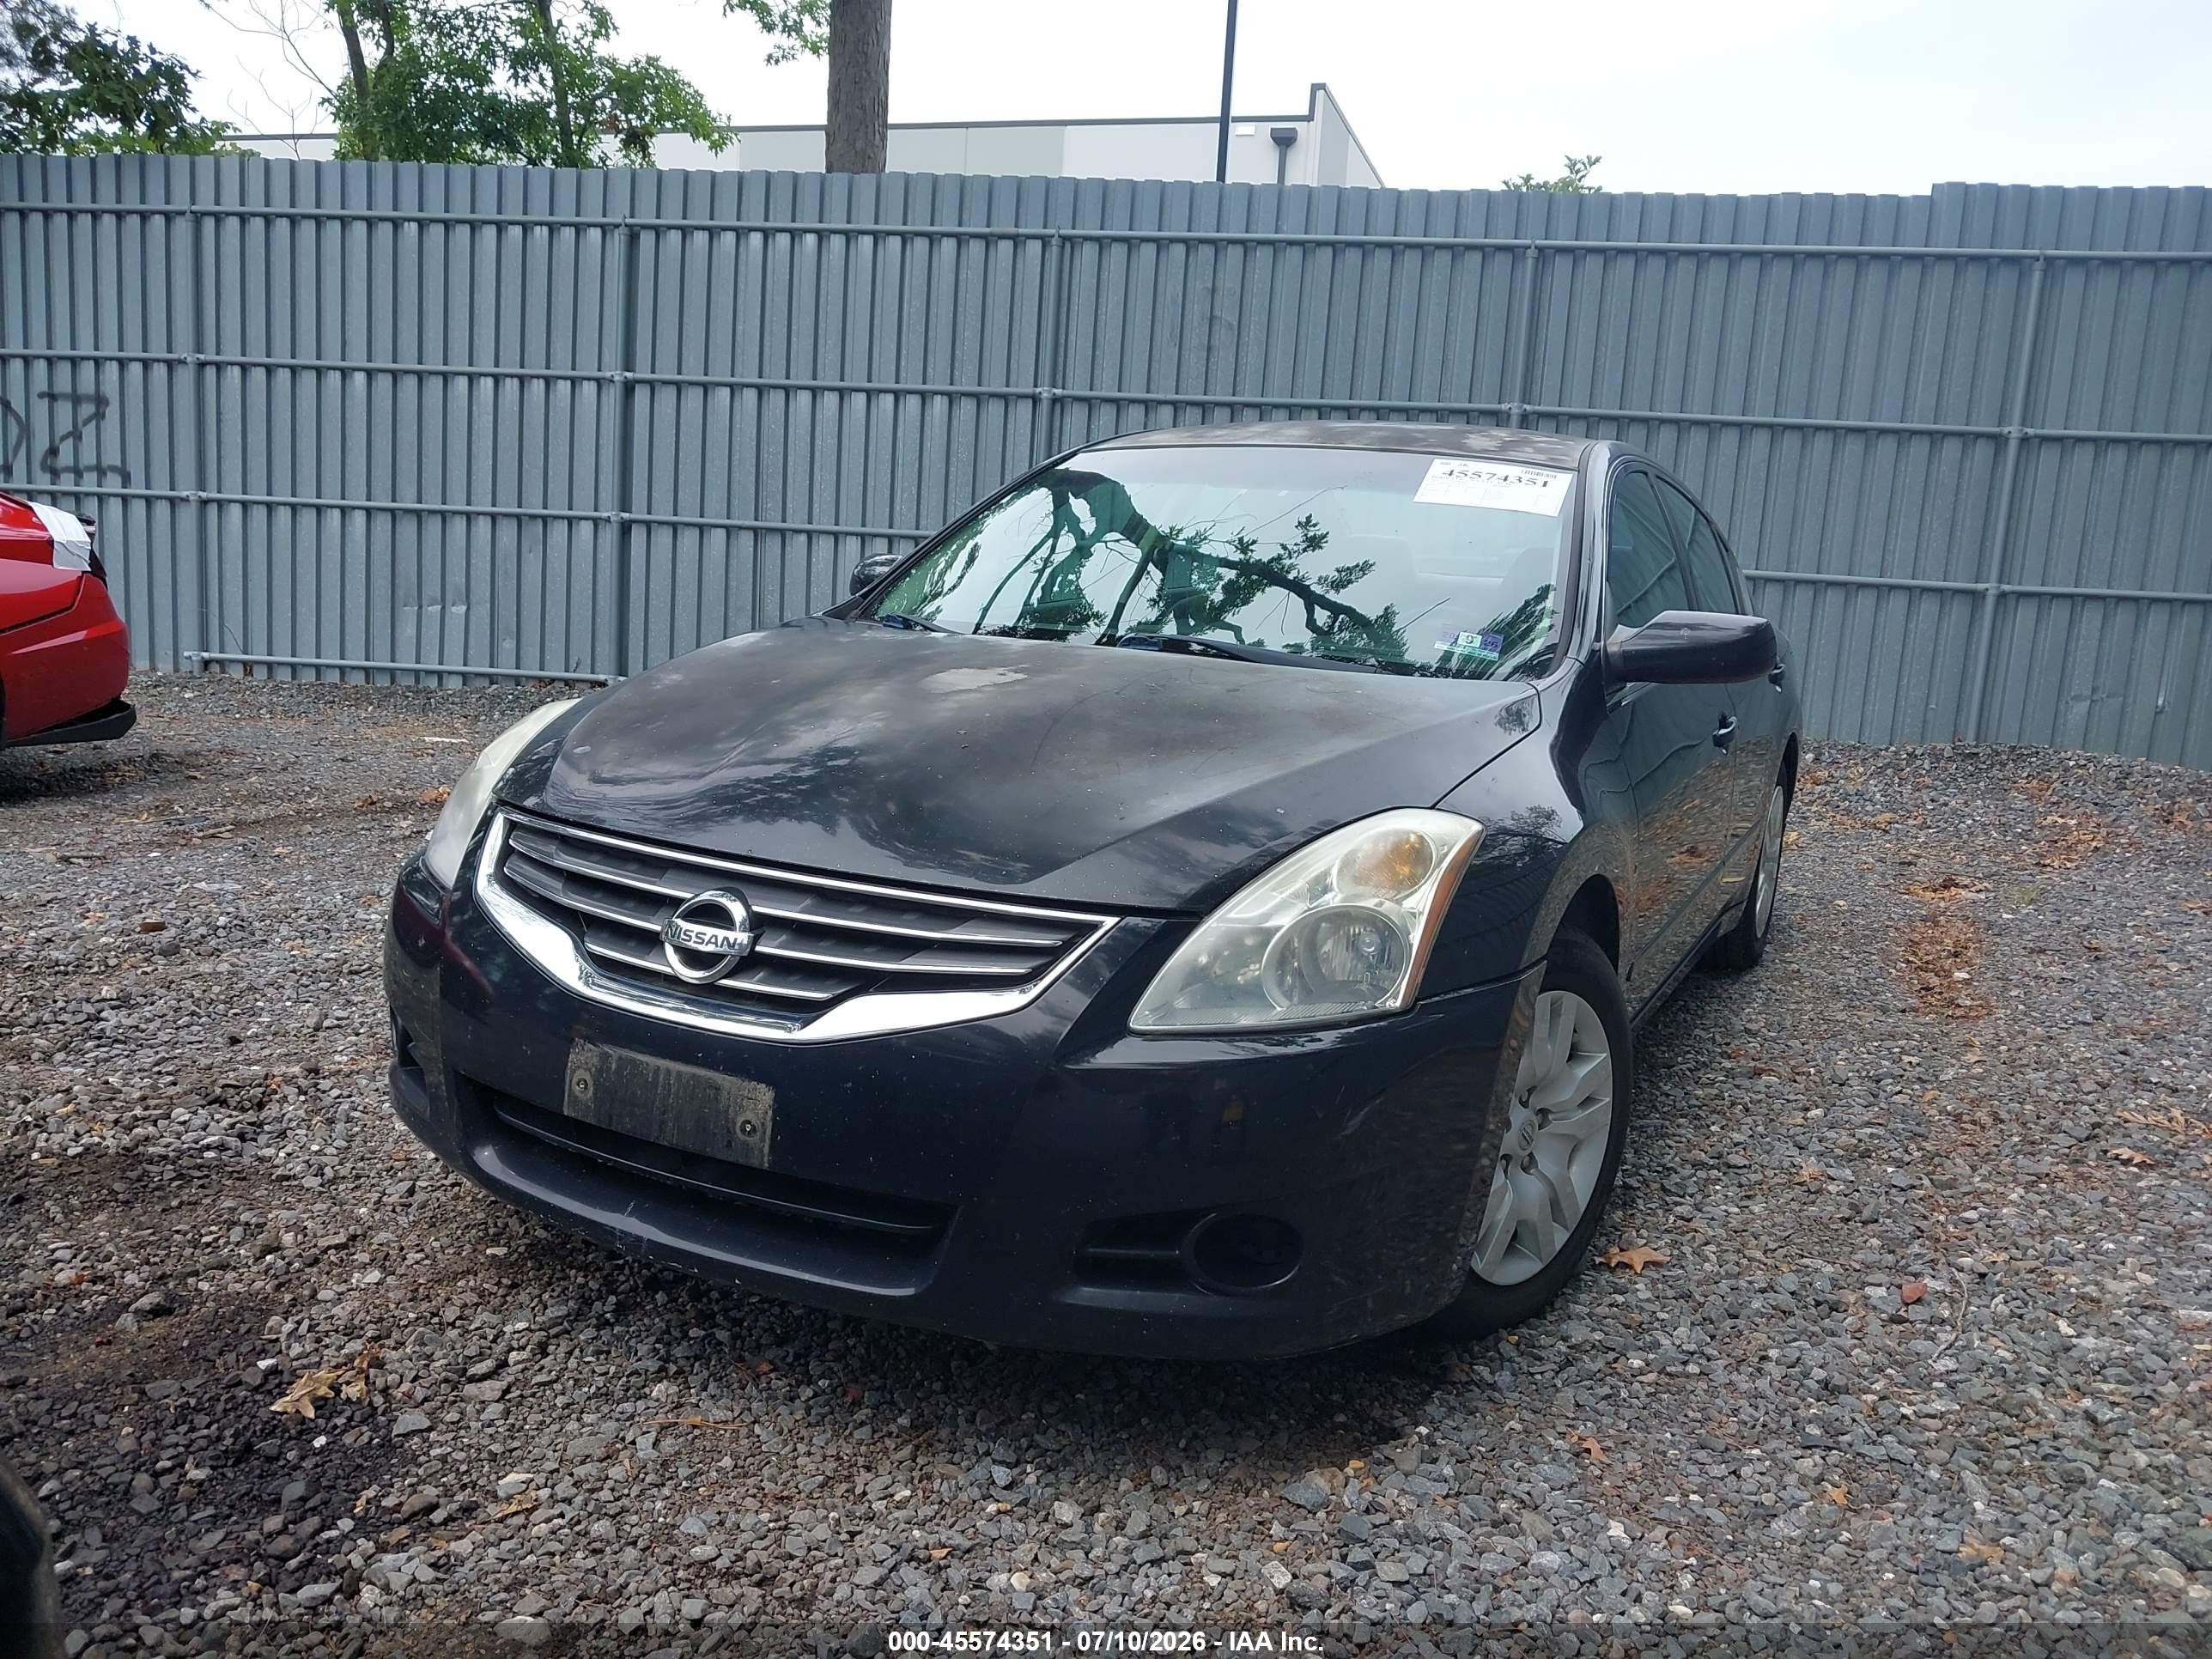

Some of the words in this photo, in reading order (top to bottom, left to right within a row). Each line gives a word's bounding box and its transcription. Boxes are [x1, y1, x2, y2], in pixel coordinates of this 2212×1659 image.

[1442, 468, 1550, 489] 45574351
[1465, 635, 1474, 645] 9
[665, 920, 738, 951] NISSAN
